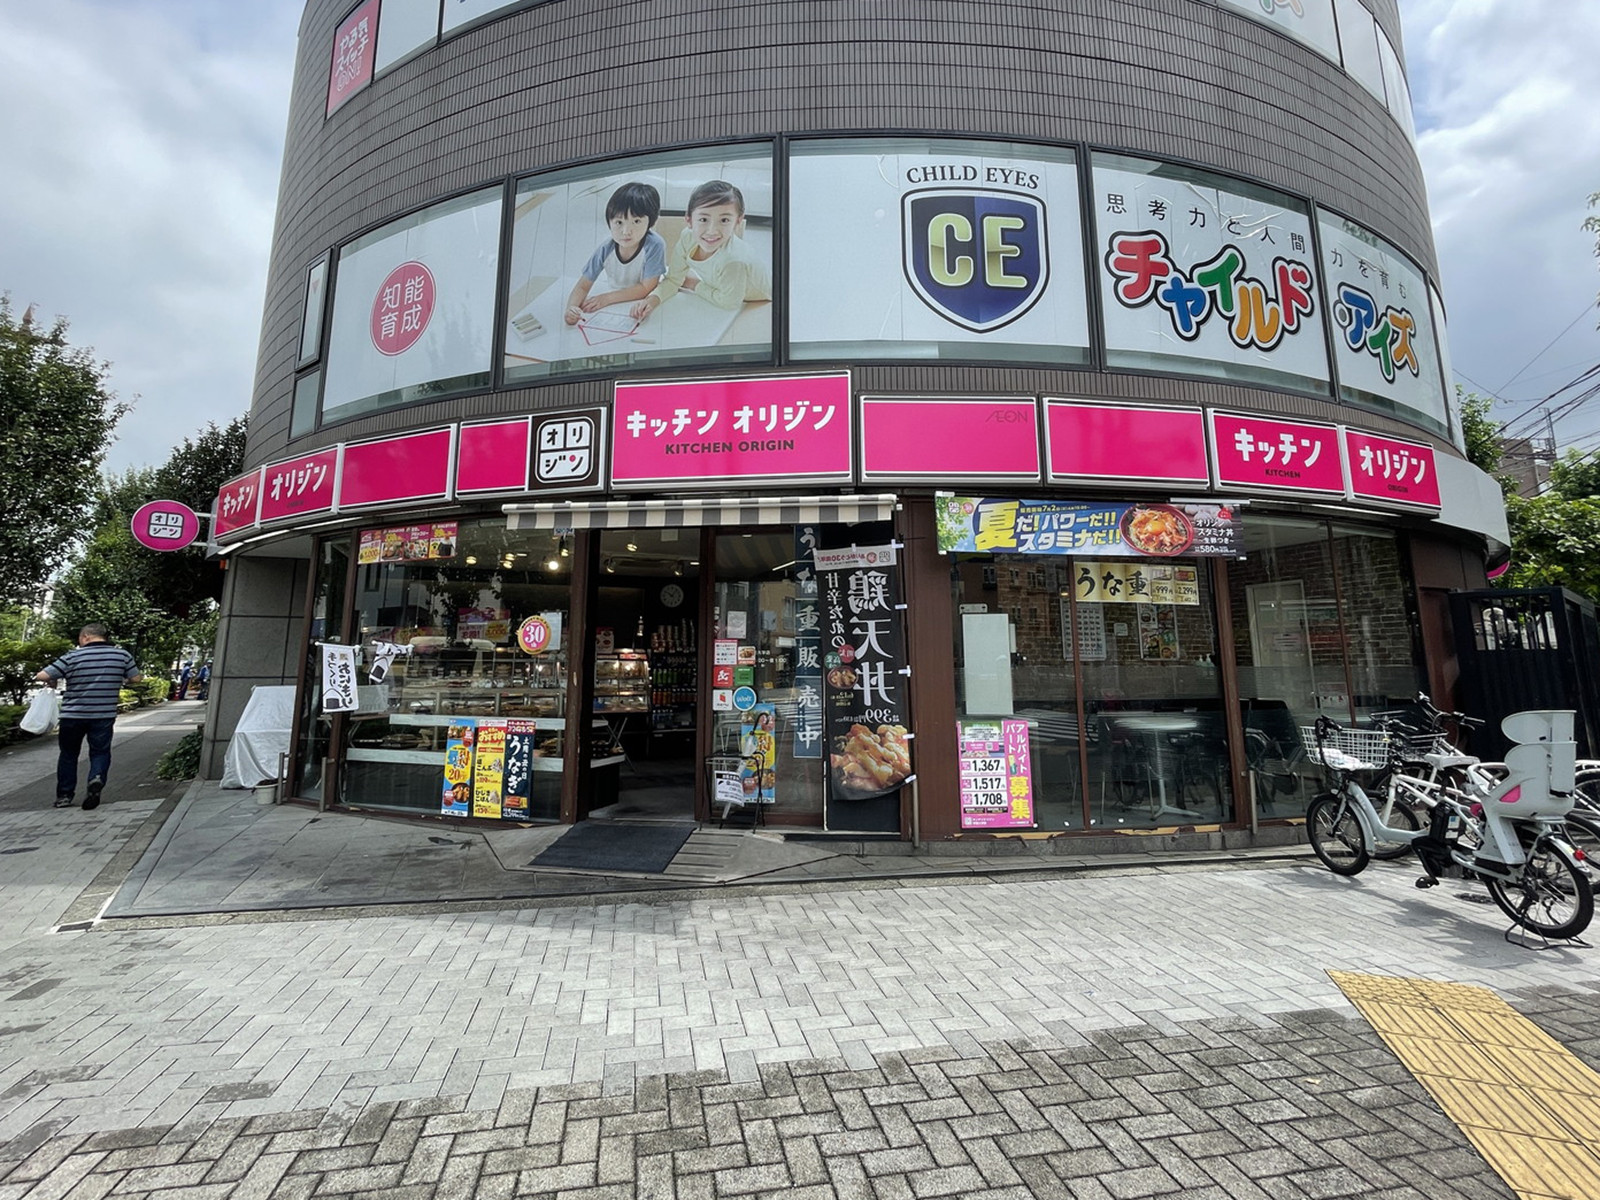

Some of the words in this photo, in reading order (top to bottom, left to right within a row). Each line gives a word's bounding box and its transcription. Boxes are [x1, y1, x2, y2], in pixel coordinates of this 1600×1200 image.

[340, 17, 368, 55] やる気
[906, 165, 978, 183] CHILD
[985, 167, 1040, 189] EYES
[1106, 193, 1306, 254] 思考力と人間
[928, 213, 1028, 288] CE
[381, 275, 425, 312] 知能
[1107, 231, 1312, 348] チャイルド
[381, 304, 422, 340] 育成
[1336, 285, 1418, 380] アイズ
[626, 409, 720, 438] キッチン
[733, 400, 836, 434] オリジン
[664, 441, 733, 455] KITCHEN
[738, 439, 795, 453] ORIGIN
[1234, 428, 1322, 468] キッチン
[1359, 445, 1426, 485] オリジン
[270, 462, 327, 501] オリジン
[1265, 468, 1301, 478] KITCHEN
[223, 485, 254, 518] キッチン
[974, 500, 1020, 551] 夏
[1077, 567, 1150, 597] うな重
[525, 626, 545, 643] 30
[1006, 724, 1017, 754] パート
[1016, 724, 1028, 774] アルバイト
[507, 735, 523, 794] うなぎ
